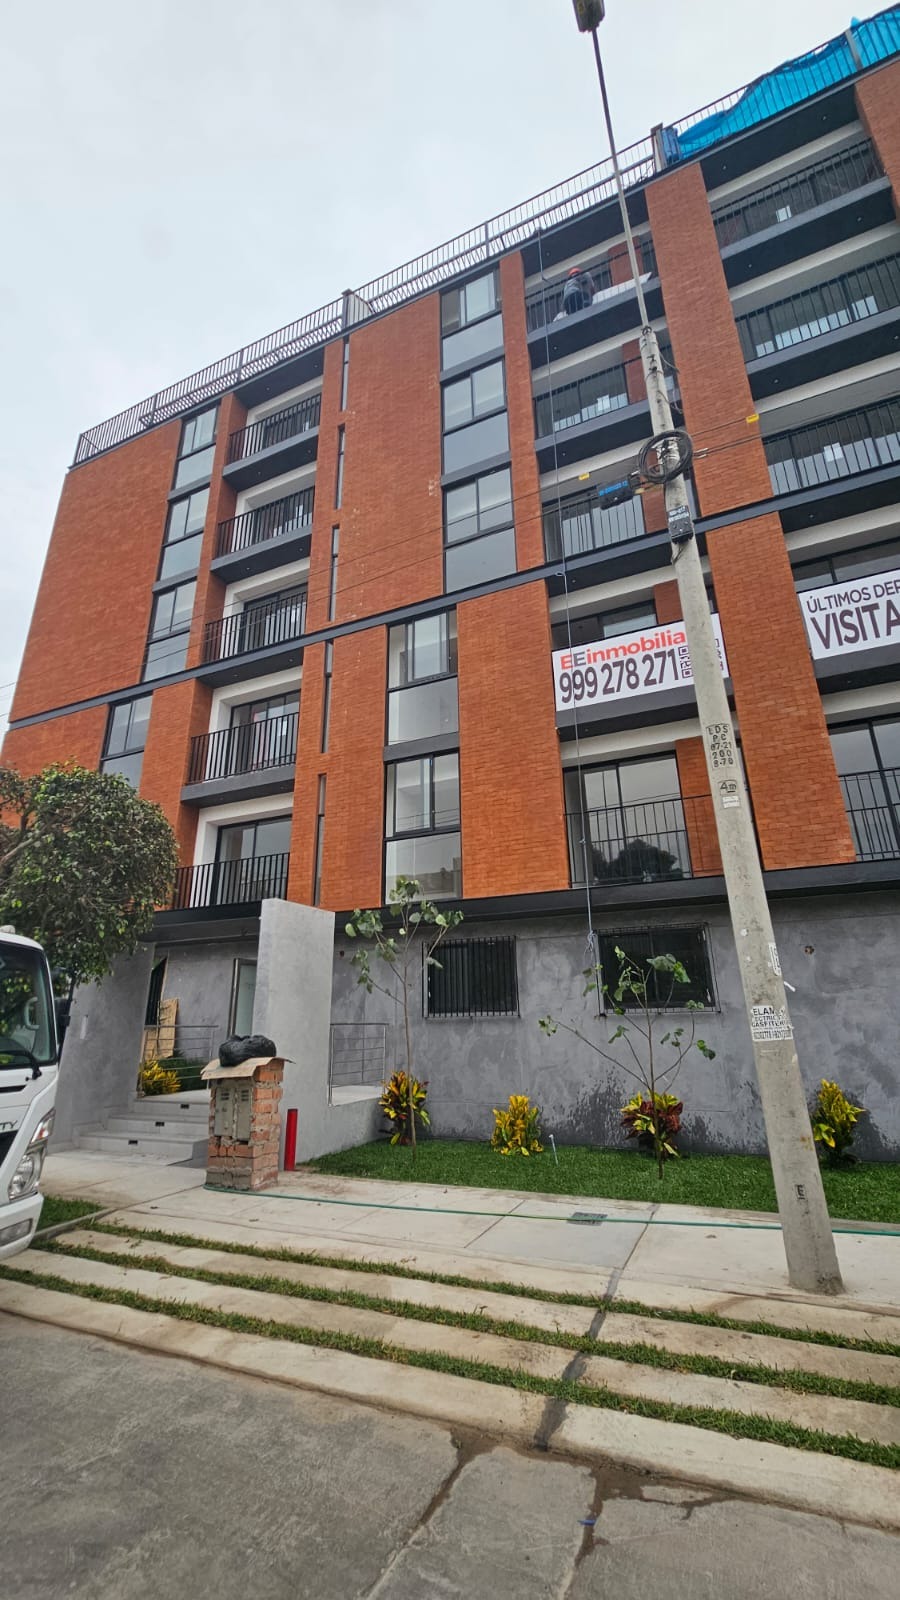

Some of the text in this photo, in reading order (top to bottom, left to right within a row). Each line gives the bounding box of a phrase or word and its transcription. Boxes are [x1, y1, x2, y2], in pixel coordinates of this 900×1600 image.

[807, 587, 871, 613] ÚLTIMOS
[810, 600, 900, 650] VISITA
[559, 666, 598, 703] 999
[600, 657, 640, 695] 278
[641, 648, 679, 687] 271
